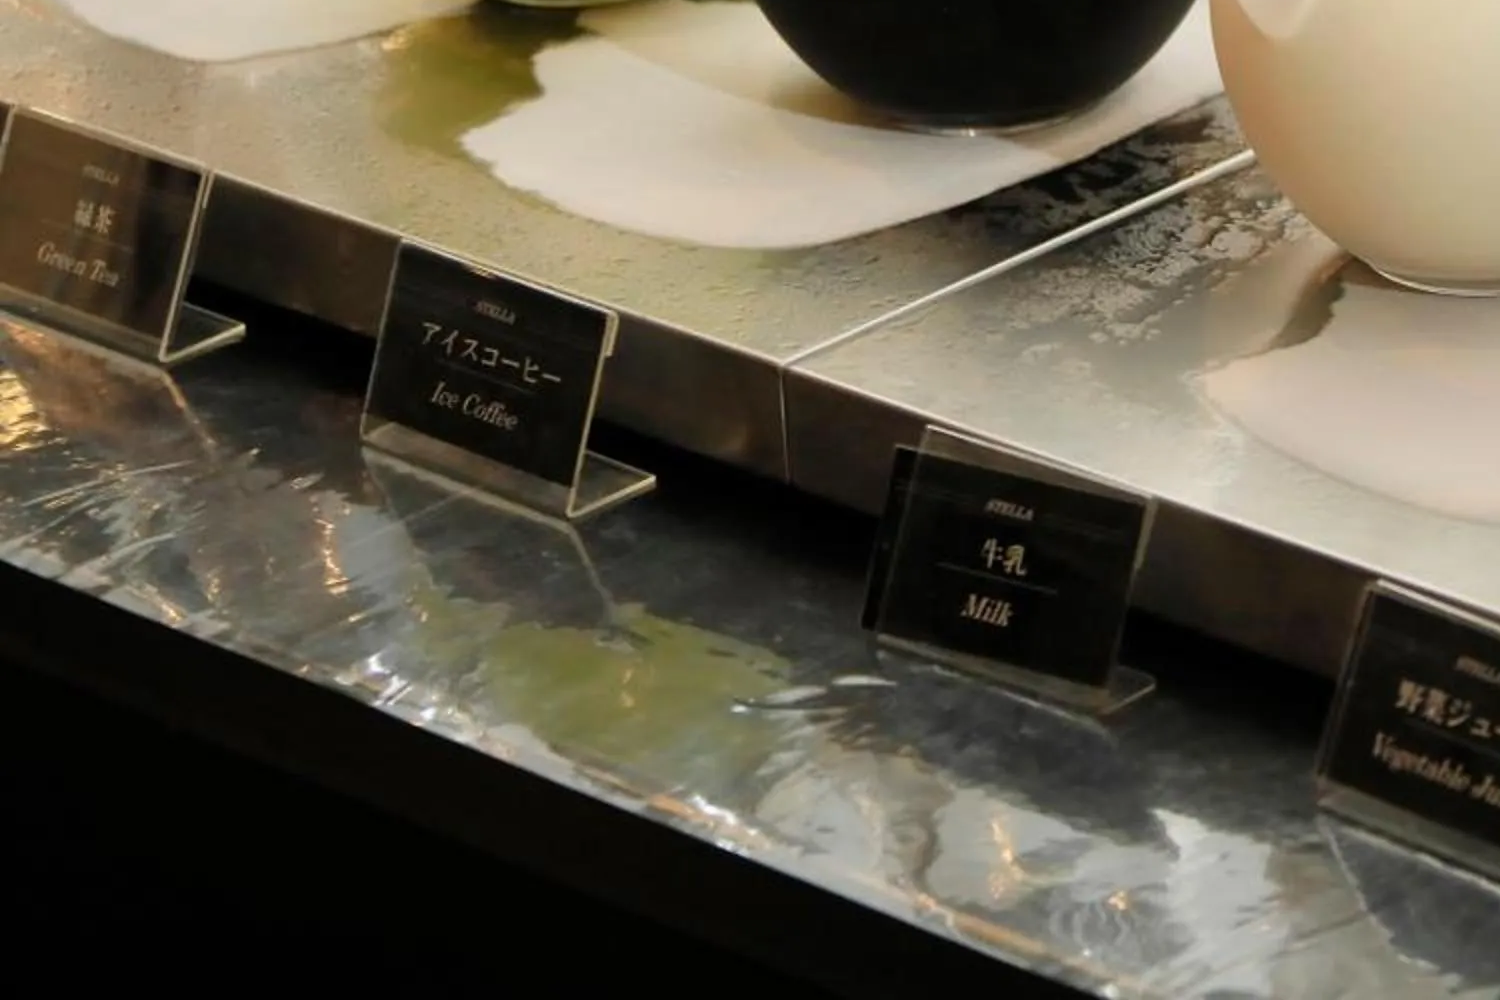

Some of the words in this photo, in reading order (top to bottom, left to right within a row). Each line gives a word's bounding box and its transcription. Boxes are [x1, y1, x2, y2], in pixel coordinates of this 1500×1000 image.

[37, 241, 87, 276] Green
[89, 261, 119, 288] Tea
[421, 321, 562, 384] アイスコーヒー
[431, 381, 458, 409] Ice
[461, 393, 519, 432] Coffee
[984, 499, 1035, 521] STELLA
[980, 537, 1029, 577] 牛乳
[960, 593, 1015, 628] Milk
[1372, 732, 1471, 794] Vegetable
